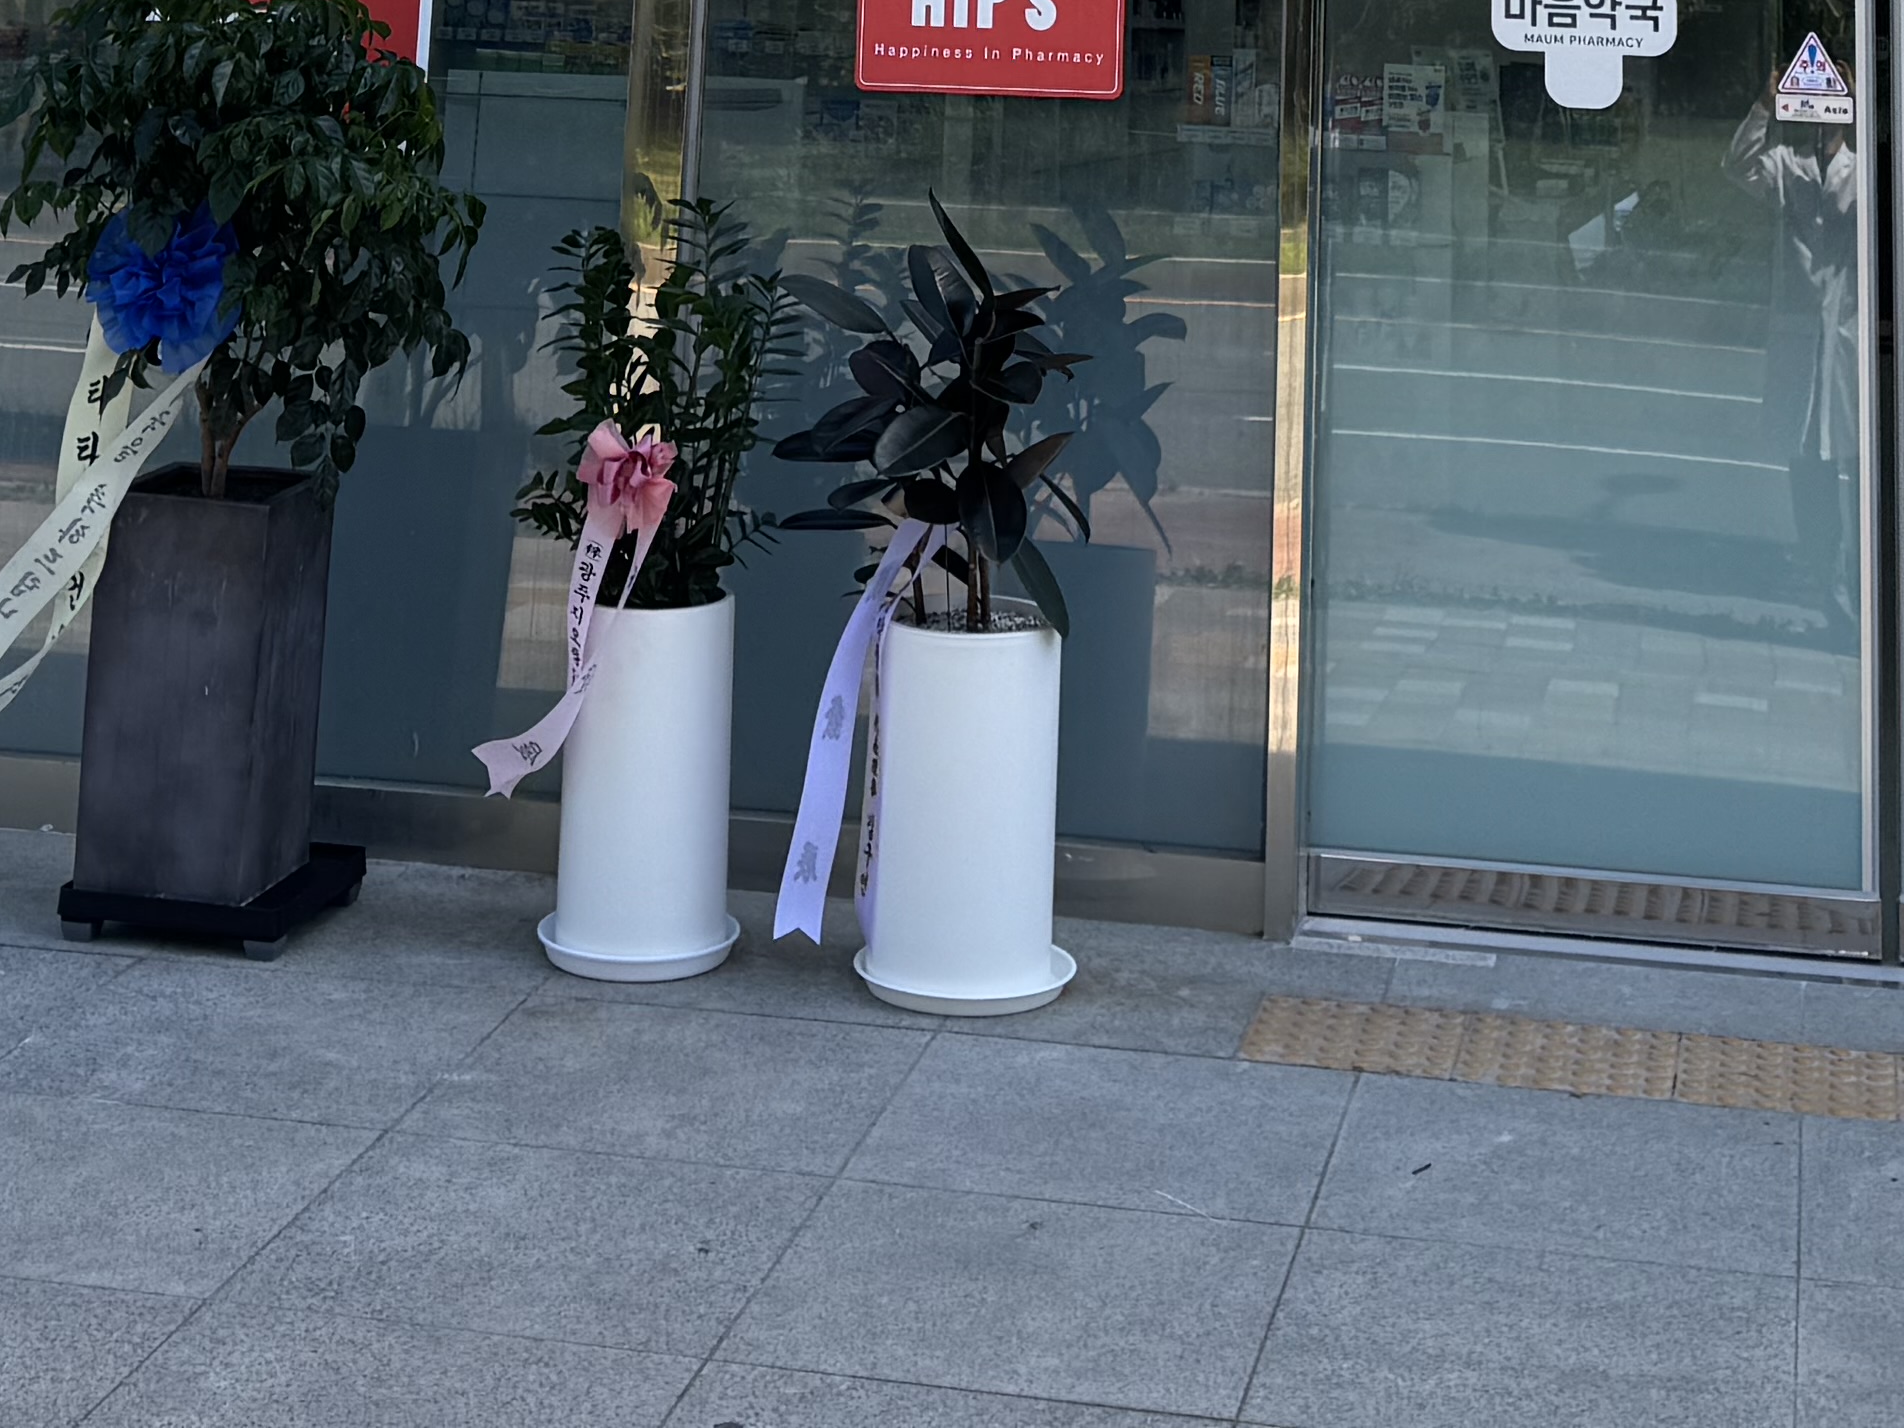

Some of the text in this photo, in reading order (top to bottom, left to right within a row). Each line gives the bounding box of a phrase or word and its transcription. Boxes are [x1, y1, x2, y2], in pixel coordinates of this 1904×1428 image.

[1523, 33, 1644, 50] MAUM PHARMACY
[874, 43, 1105, 66] Happiness In Pharmacy
